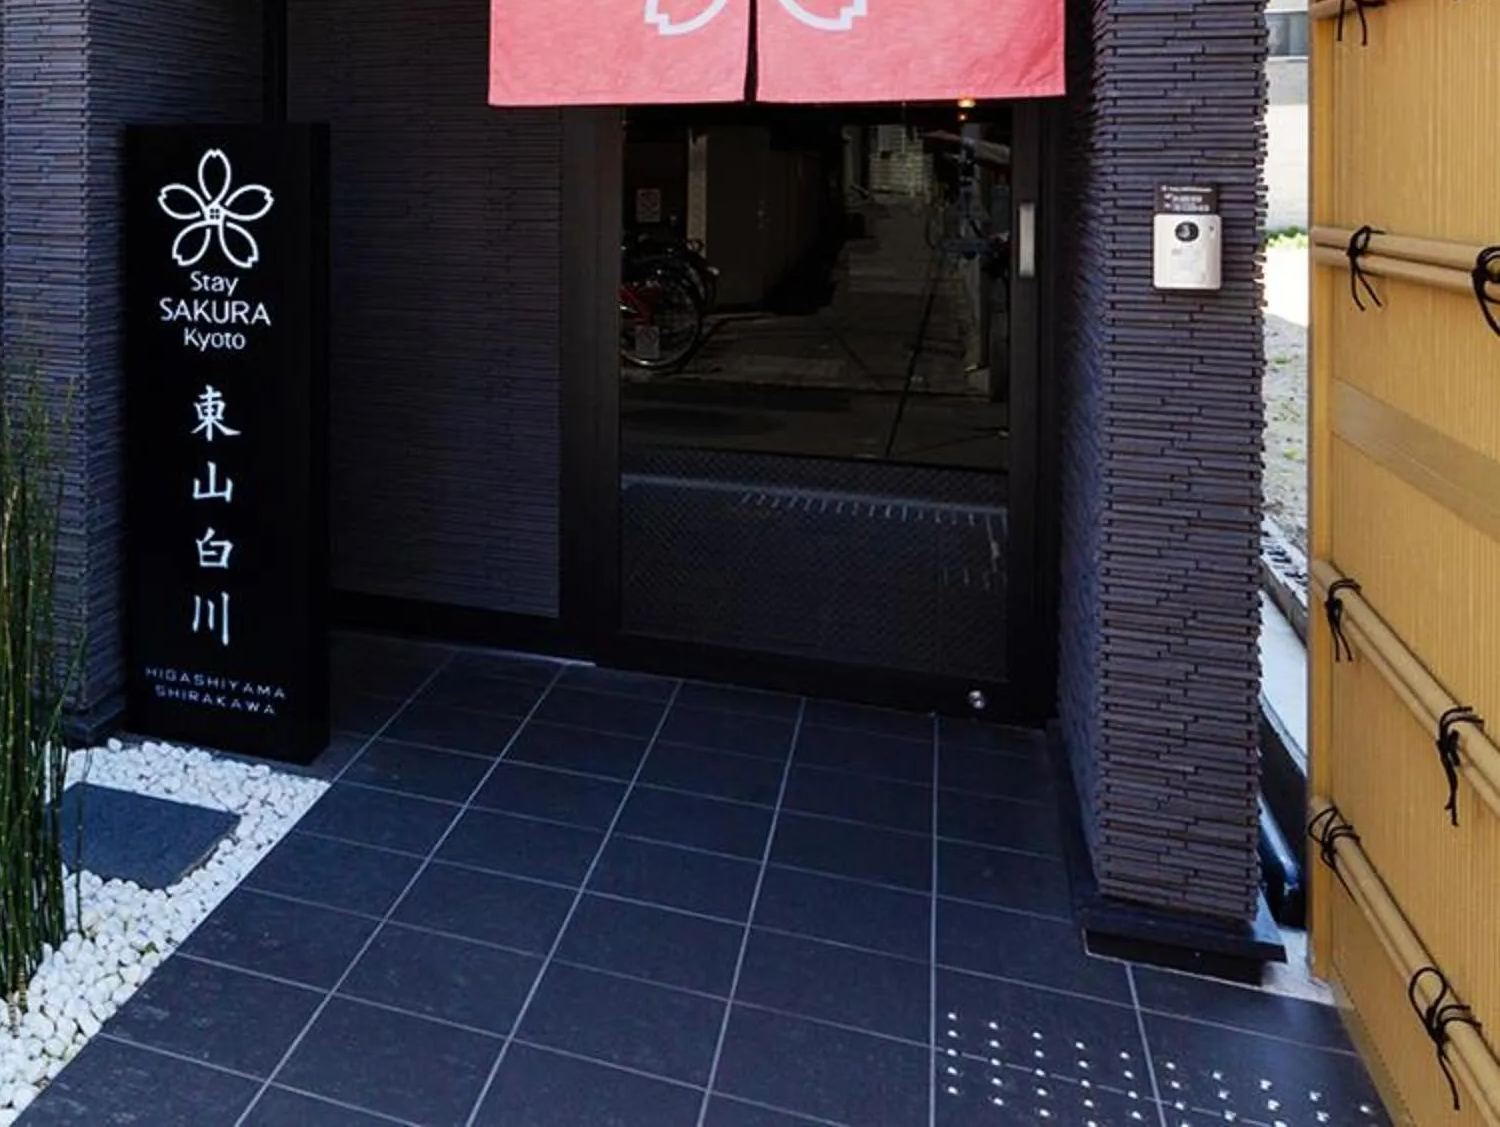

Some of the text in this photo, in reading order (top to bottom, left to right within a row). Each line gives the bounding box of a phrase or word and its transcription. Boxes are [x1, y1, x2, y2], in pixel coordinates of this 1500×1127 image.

[190, 270, 239, 297] Stay
[159, 296, 272, 326] SAKURA
[184, 327, 246, 352] Kyoto
[191, 384, 241, 646] 東山白川
[146, 668, 285, 698] HIGASHIYAMA
[155, 684, 275, 714] SHIRAKAWA
